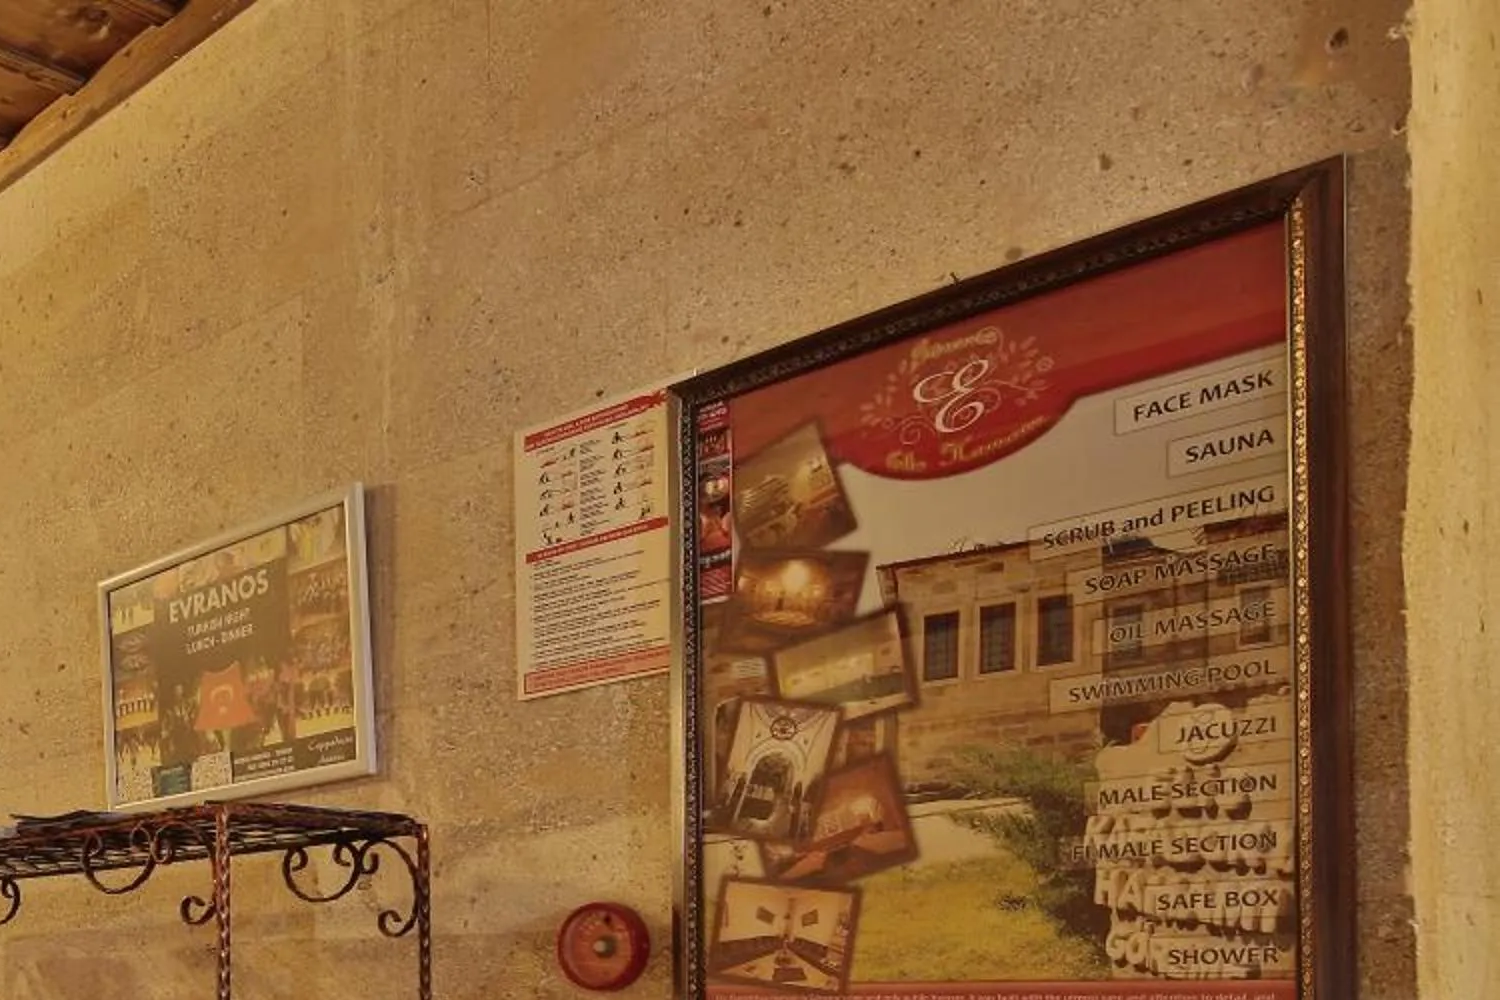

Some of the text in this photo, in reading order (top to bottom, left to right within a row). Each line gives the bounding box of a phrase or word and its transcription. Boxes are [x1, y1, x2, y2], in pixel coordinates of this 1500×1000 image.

[1132, 369, 1274, 422] FACE MASK
[1184, 428, 1274, 464] SAUNA
[1043, 485, 1275, 549] SCRUB and PEELING
[1083, 543, 1275, 596] SOAP MASSAGE
[168, 569, 269, 624] EVRANOS
[1109, 601, 1277, 644] OIL MASSAGE
[1068, 659, 1277, 703] SWIMMING POOL
[1175, 716, 1277, 745] JACUZZI
[1100, 774, 1277, 805] MALE SECTION
[1171, 831, 1277, 854] SECTION
[1157, 889, 1279, 911] SAFE BOX
[1168, 947, 1279, 965] SHOWER
